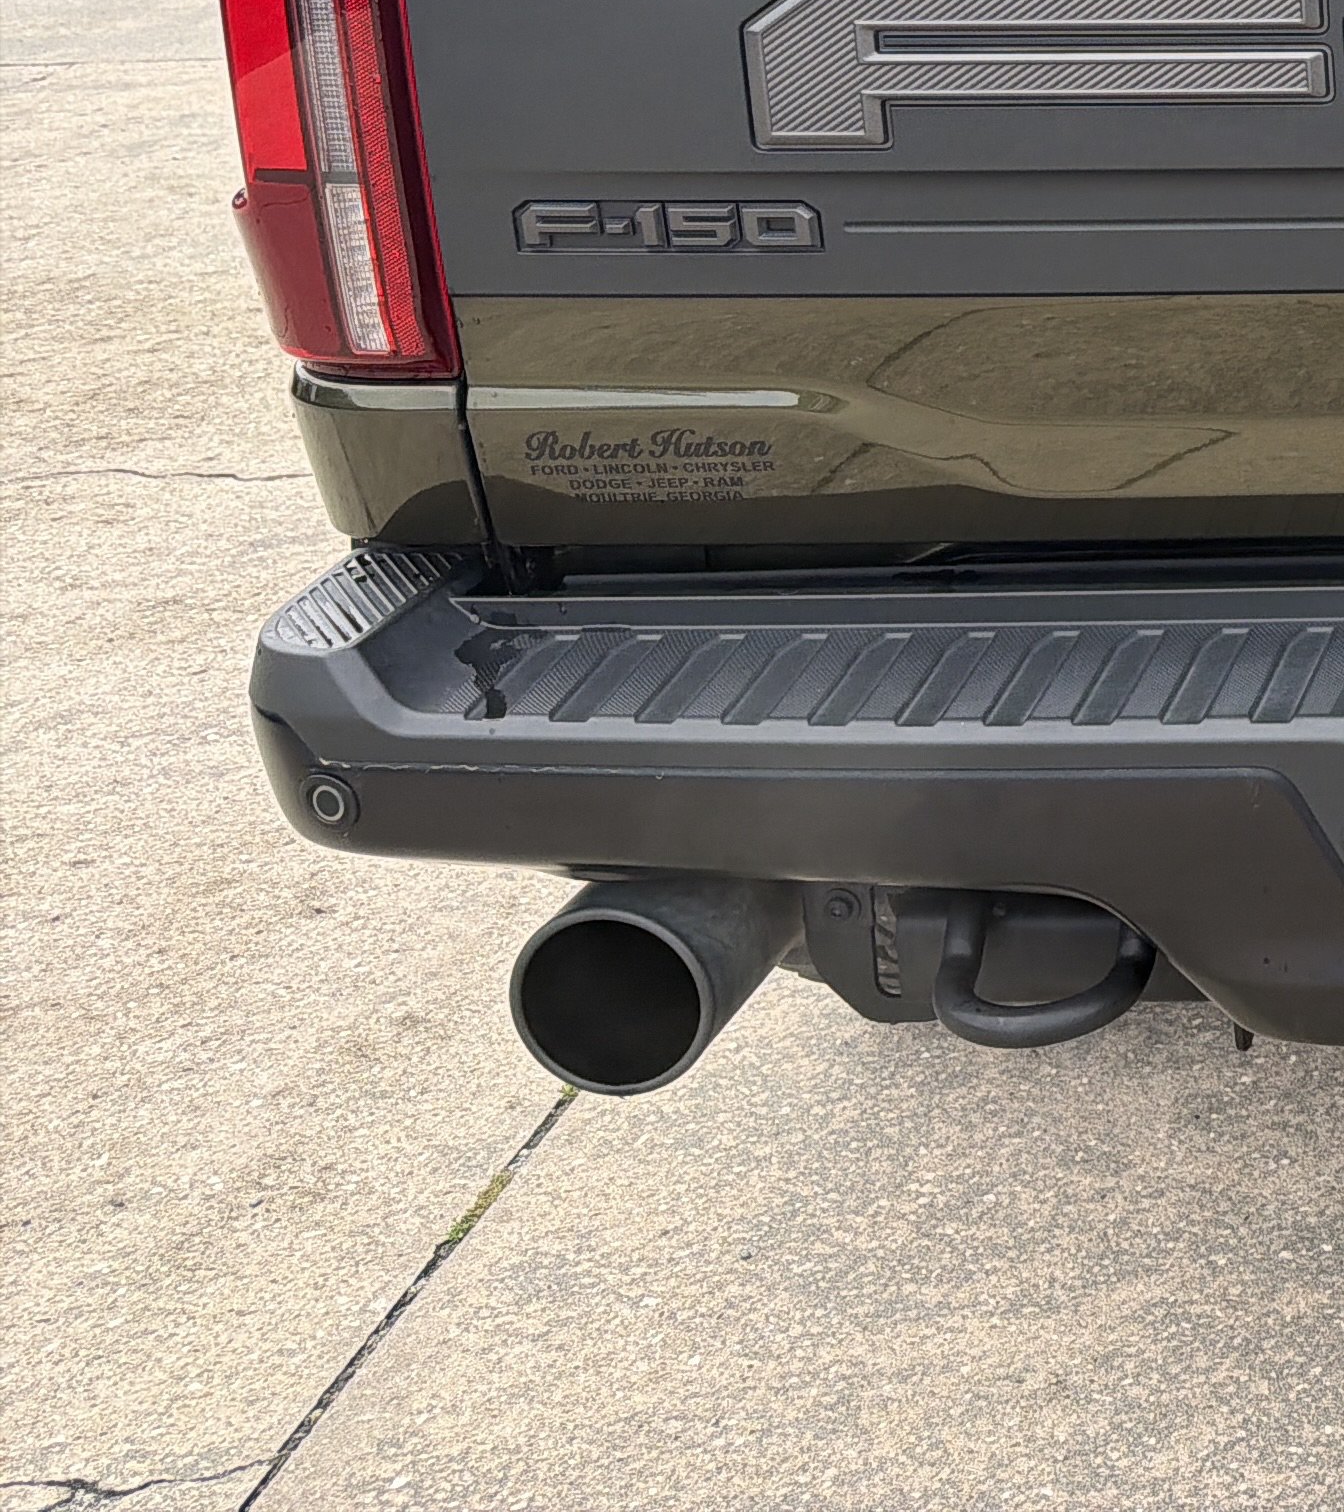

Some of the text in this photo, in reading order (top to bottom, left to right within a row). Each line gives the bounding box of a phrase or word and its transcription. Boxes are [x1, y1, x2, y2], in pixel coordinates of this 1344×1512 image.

[513, 199, 824, 251] F-150
[525, 428, 773, 461] Robert Hutson
[530, 461, 775, 476] FORD LINCOLN CHRYSLER
[569, 476, 744, 490] DODGE JEEP RAM
[666, 490, 744, 502] GEORGIA
